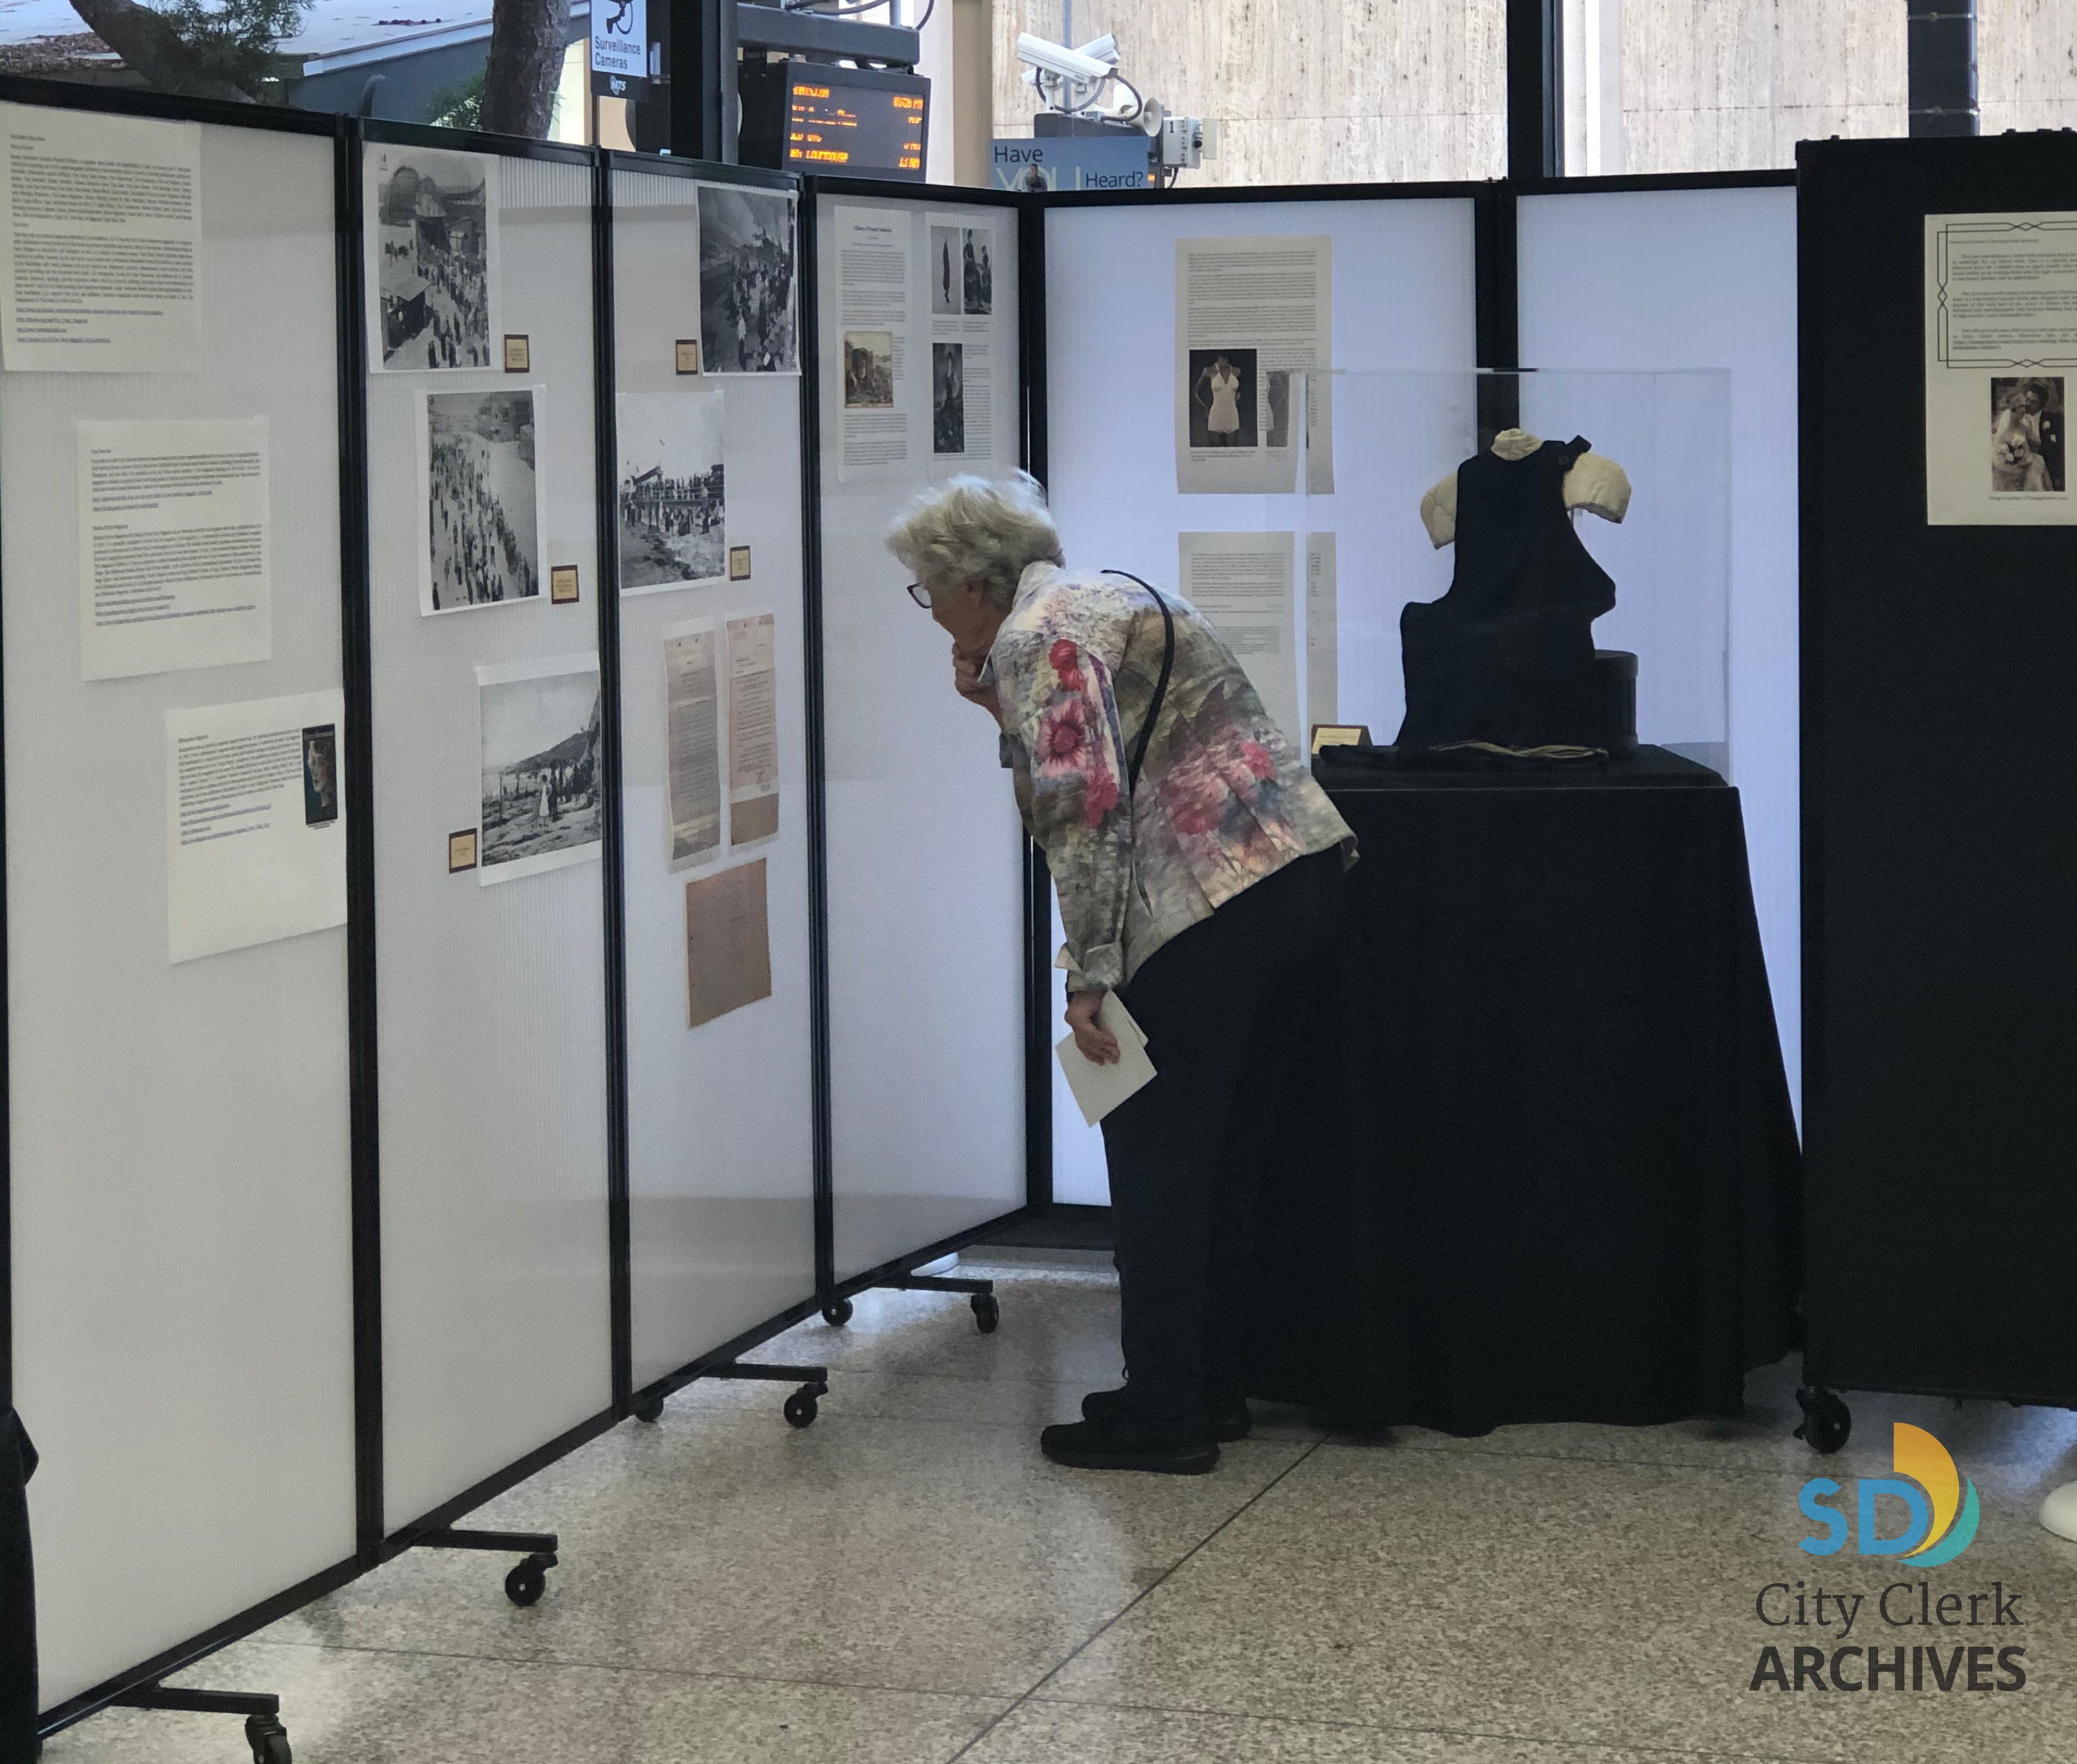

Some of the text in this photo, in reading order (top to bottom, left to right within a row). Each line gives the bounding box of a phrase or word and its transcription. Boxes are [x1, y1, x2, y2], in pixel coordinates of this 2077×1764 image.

[594, 36, 641, 55] Surveillance
[595, 52, 628, 69] Cameras
[1169, 121, 1174, 133] 1
[995, 146, 1043, 163] Have
[1086, 171, 1144, 188] Heard?
